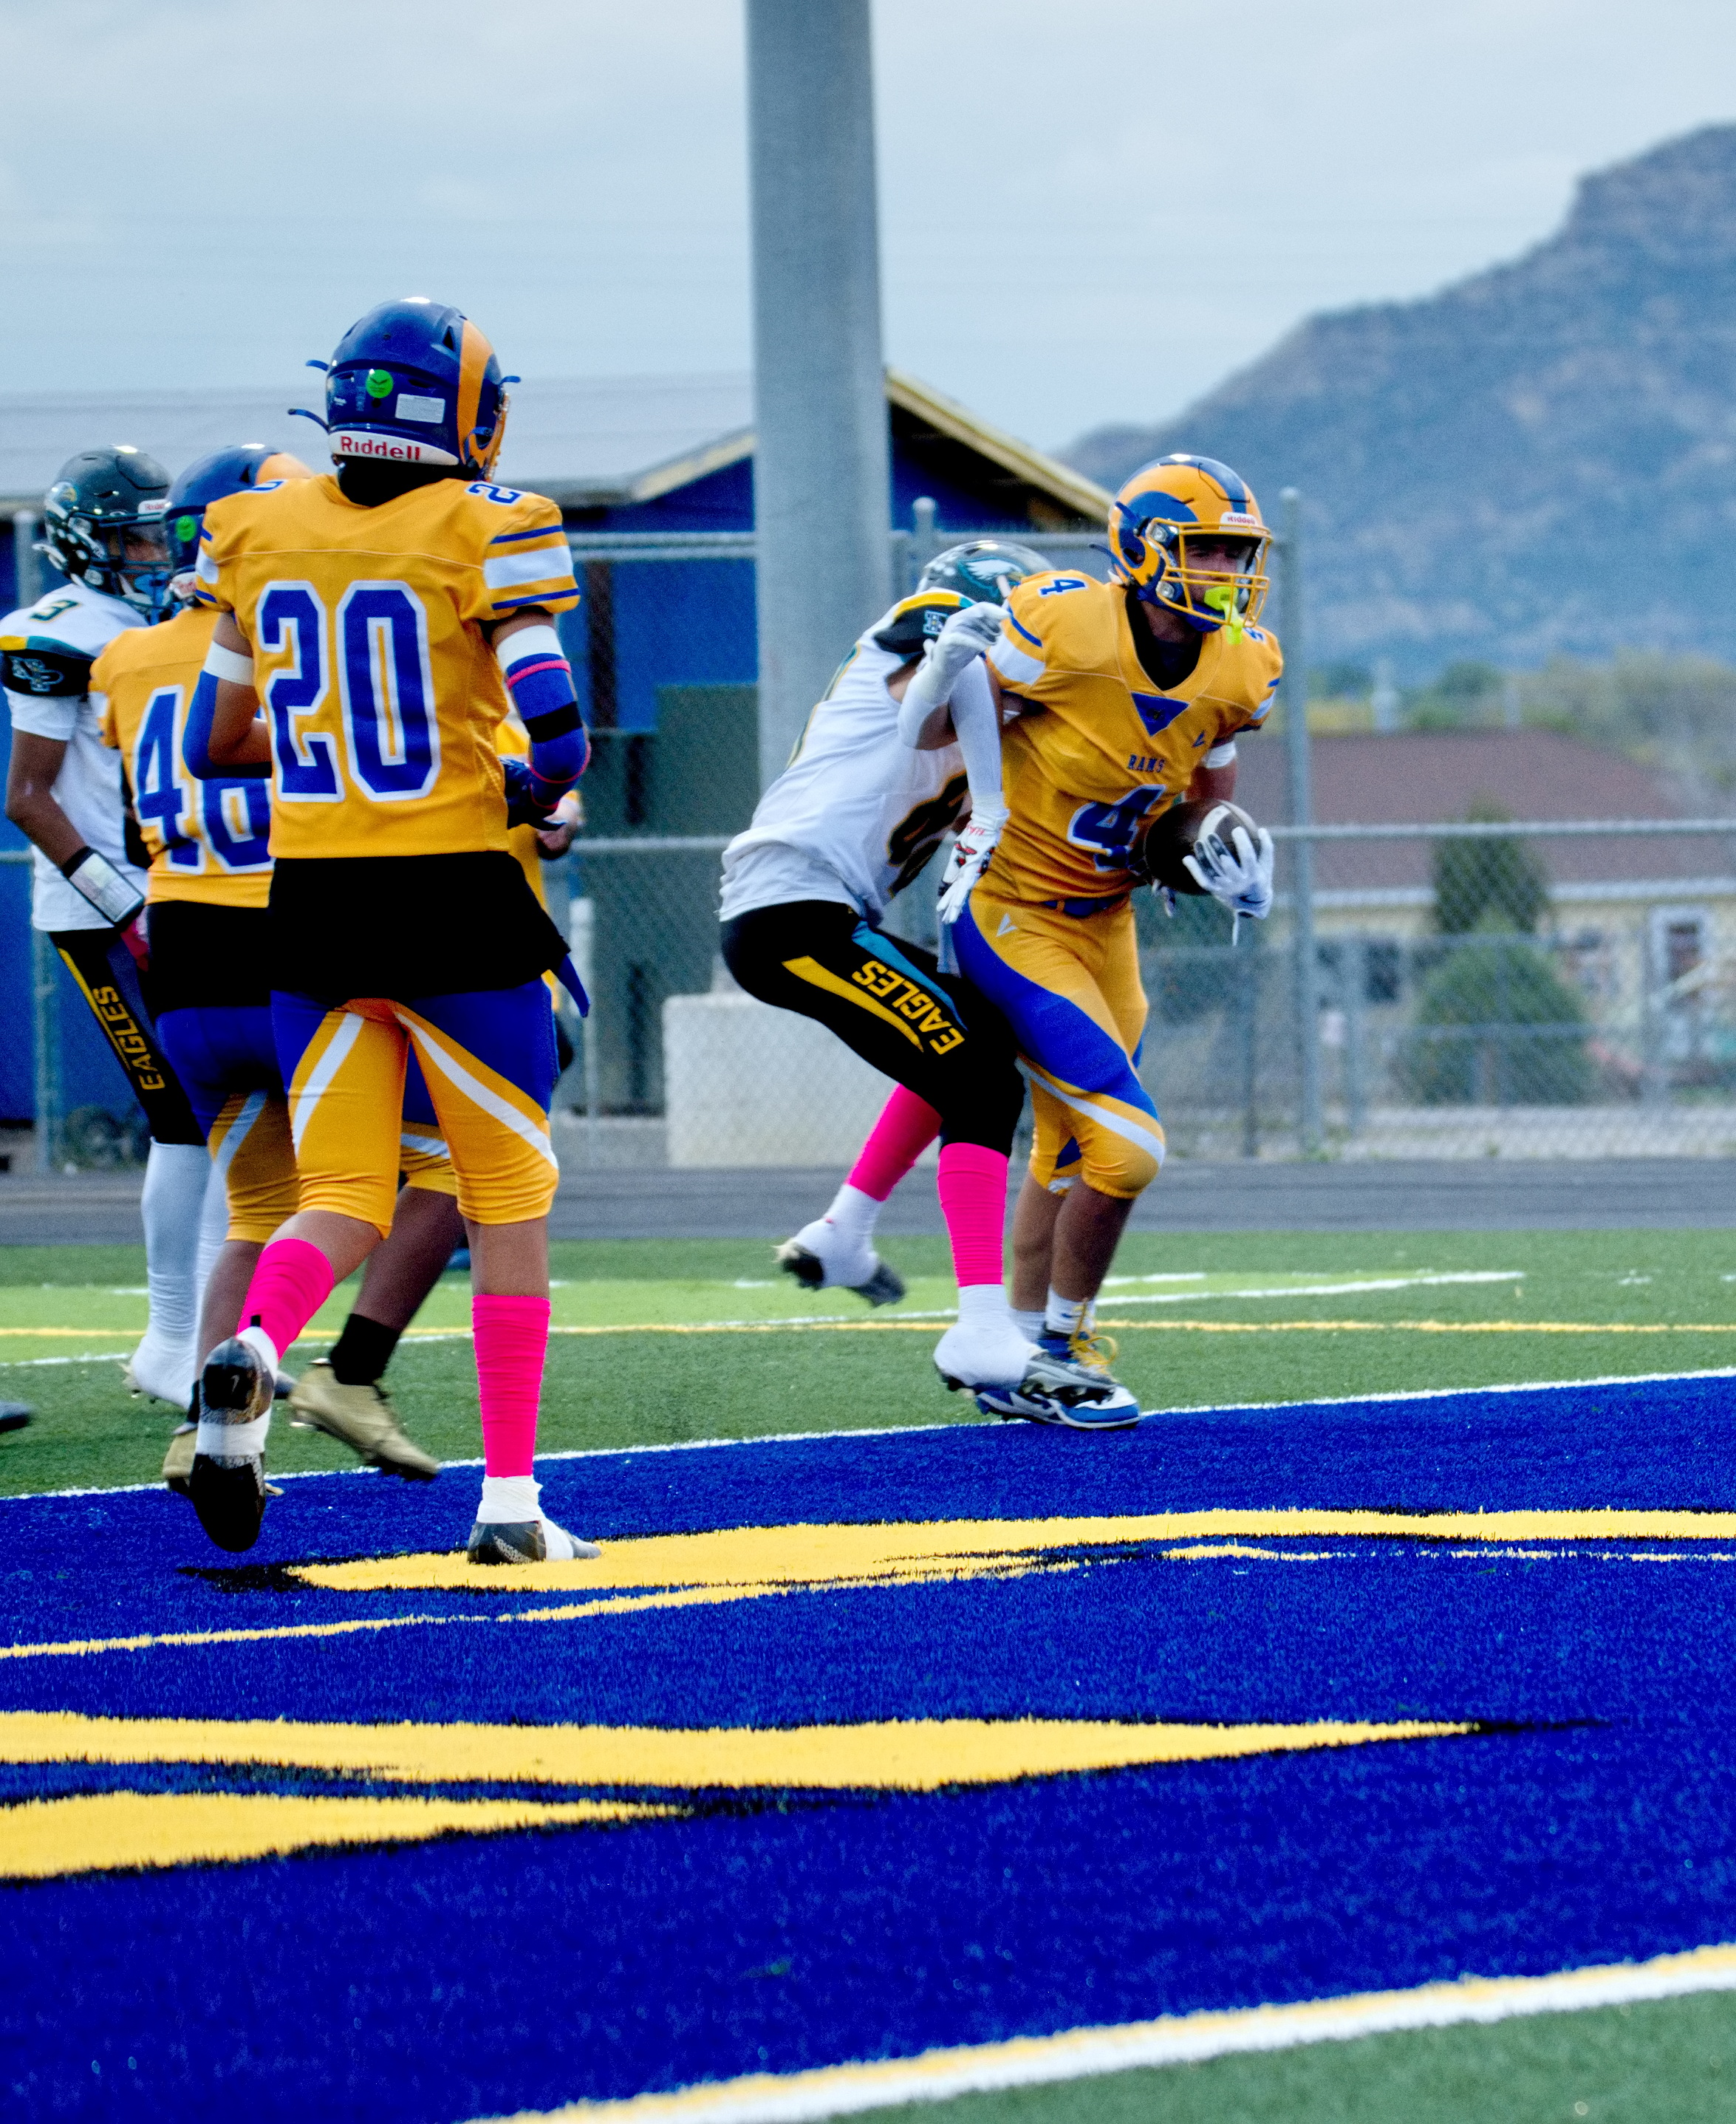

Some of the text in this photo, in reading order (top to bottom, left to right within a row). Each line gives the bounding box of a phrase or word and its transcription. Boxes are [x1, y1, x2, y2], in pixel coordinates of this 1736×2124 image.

[341, 435, 421, 461] Riddell
[1037, 577, 1089, 598] 4
[256, 580, 441, 802] 20
[1127, 754, 1166, 773] RAMS
[1067, 784, 1166, 873] 4
[92, 986, 166, 1090] EAGLES
[852, 960, 965, 1055] EAGLES
